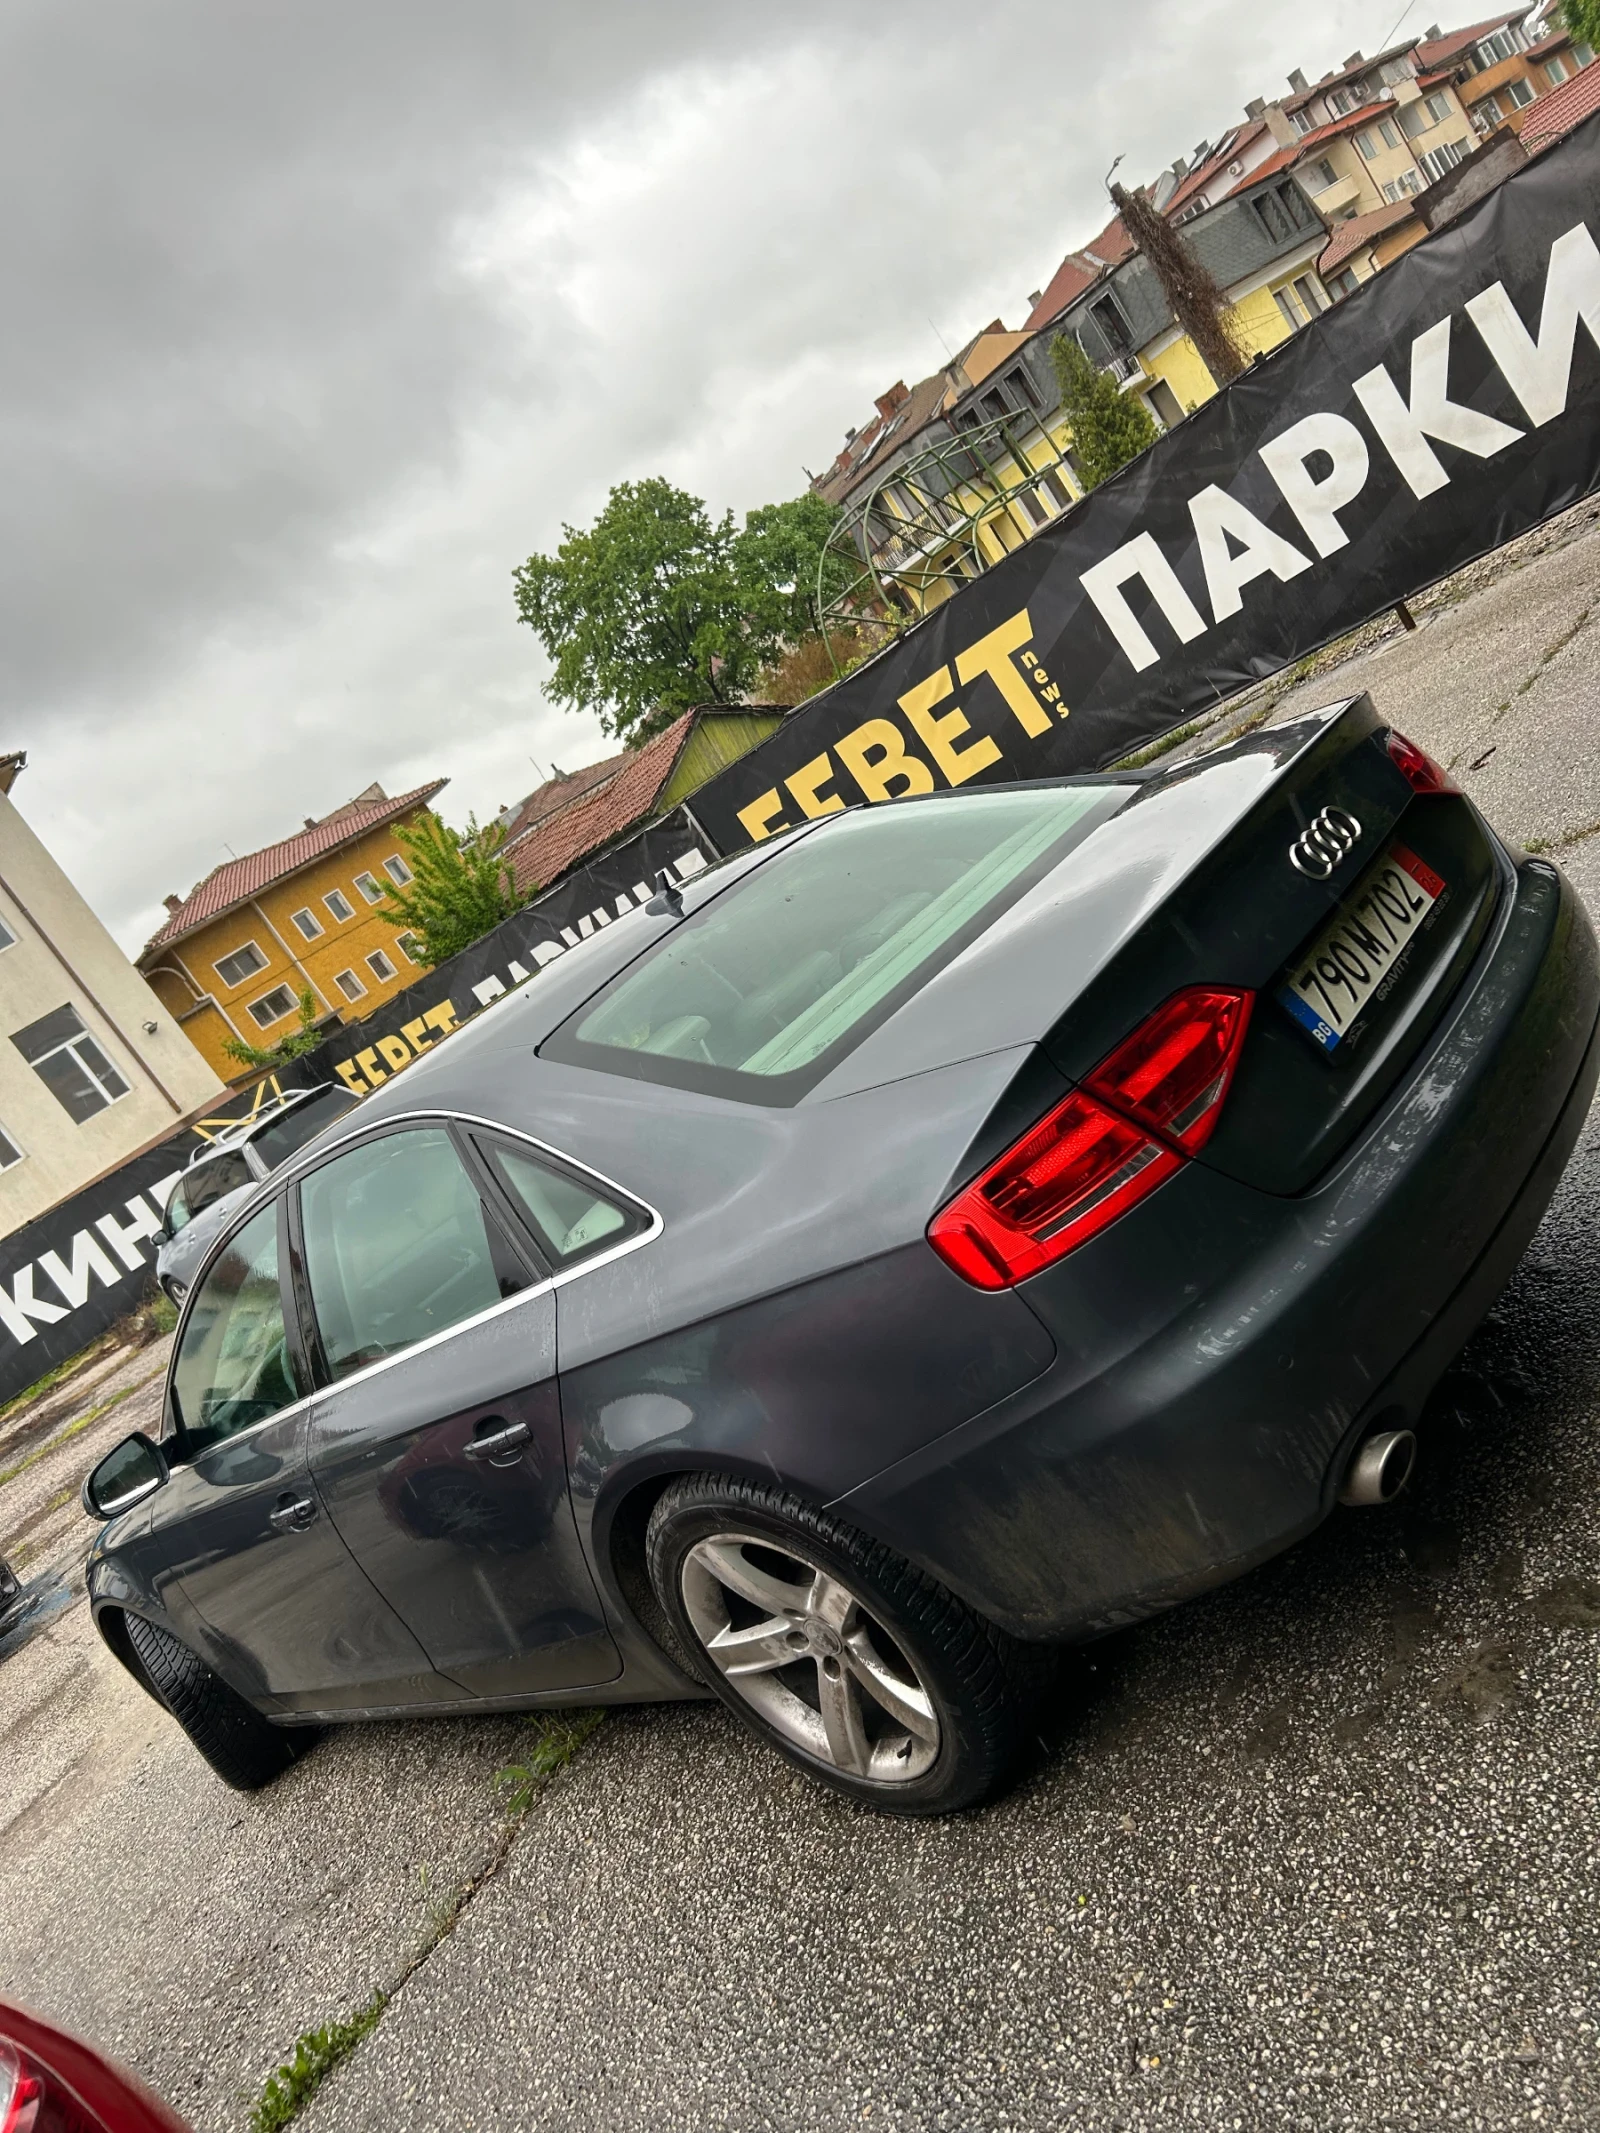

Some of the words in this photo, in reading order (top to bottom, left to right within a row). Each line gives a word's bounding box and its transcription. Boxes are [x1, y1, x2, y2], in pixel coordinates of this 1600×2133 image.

[1079, 222, 1600, 673] ПАРКИ
[1020, 650, 1070, 719] news
[1376, 956, 1409, 1001] GRAVITY
[1312, 1021, 1333, 1044] BG
